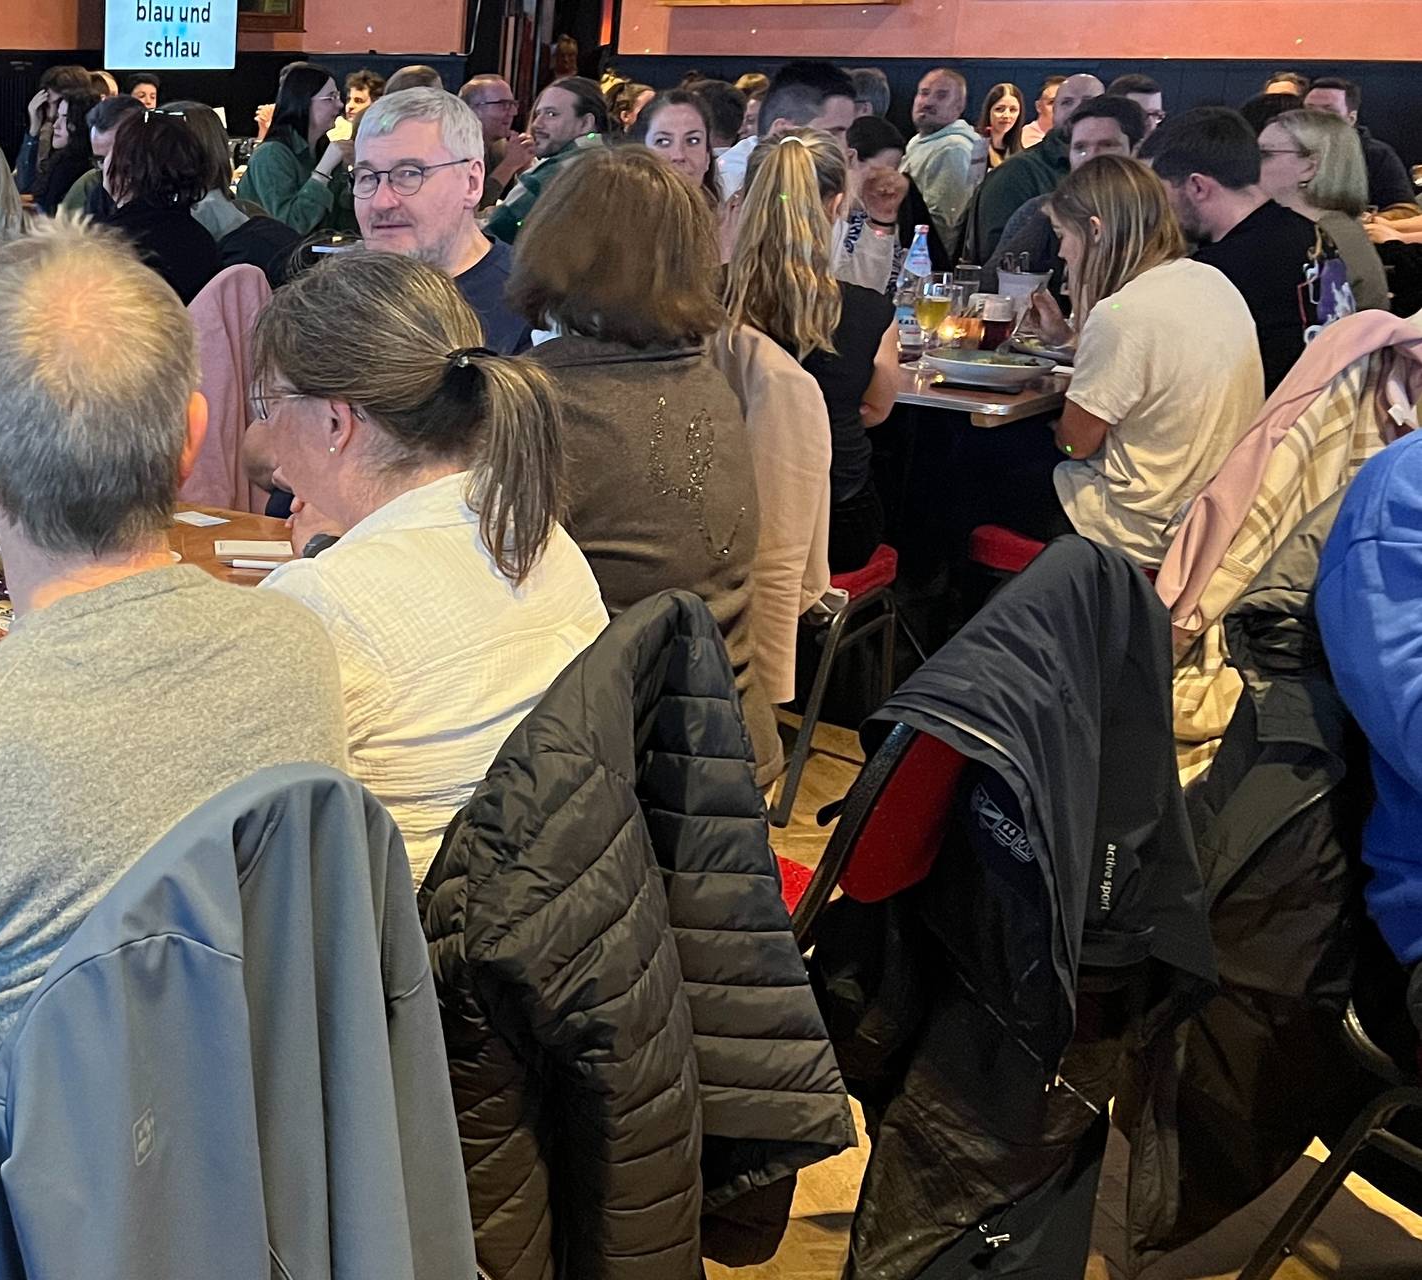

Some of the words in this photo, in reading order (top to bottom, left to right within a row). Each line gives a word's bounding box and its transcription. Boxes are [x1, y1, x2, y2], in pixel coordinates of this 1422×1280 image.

[137, 0, 174, 22] blau
[179, 2, 211, 23] und
[145, 36, 200, 57] schlau
[1104, 843, 1117, 878] active
[1099, 879, 1113, 911] sport
